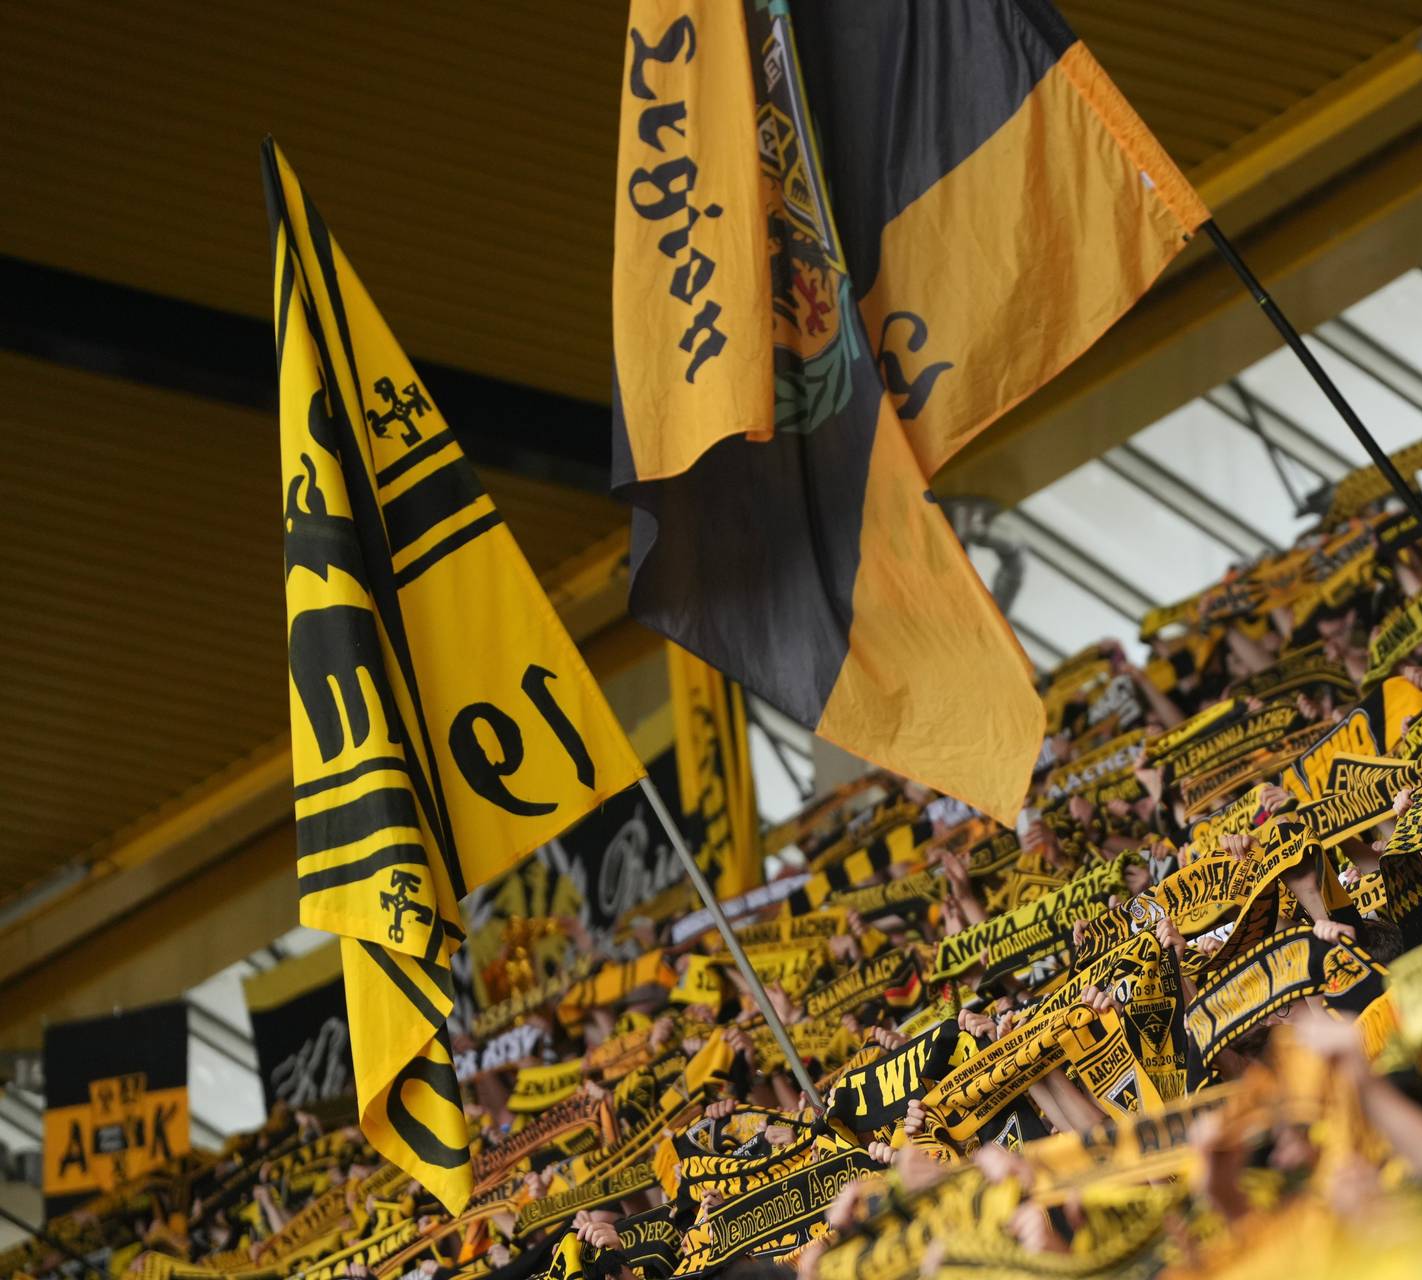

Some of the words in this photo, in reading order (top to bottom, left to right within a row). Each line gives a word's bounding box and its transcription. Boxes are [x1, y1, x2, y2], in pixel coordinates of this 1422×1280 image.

[1129, 1000, 1172, 1016] Alemannia
[953, 1057, 989, 1088] SCHWARZ
[988, 1048, 1005, 1064] UND
[1005, 1035, 1024, 1053] GELB
[1087, 1041, 1128, 1085] AACHEN
[709, 1181, 805, 1259] Alemannia
